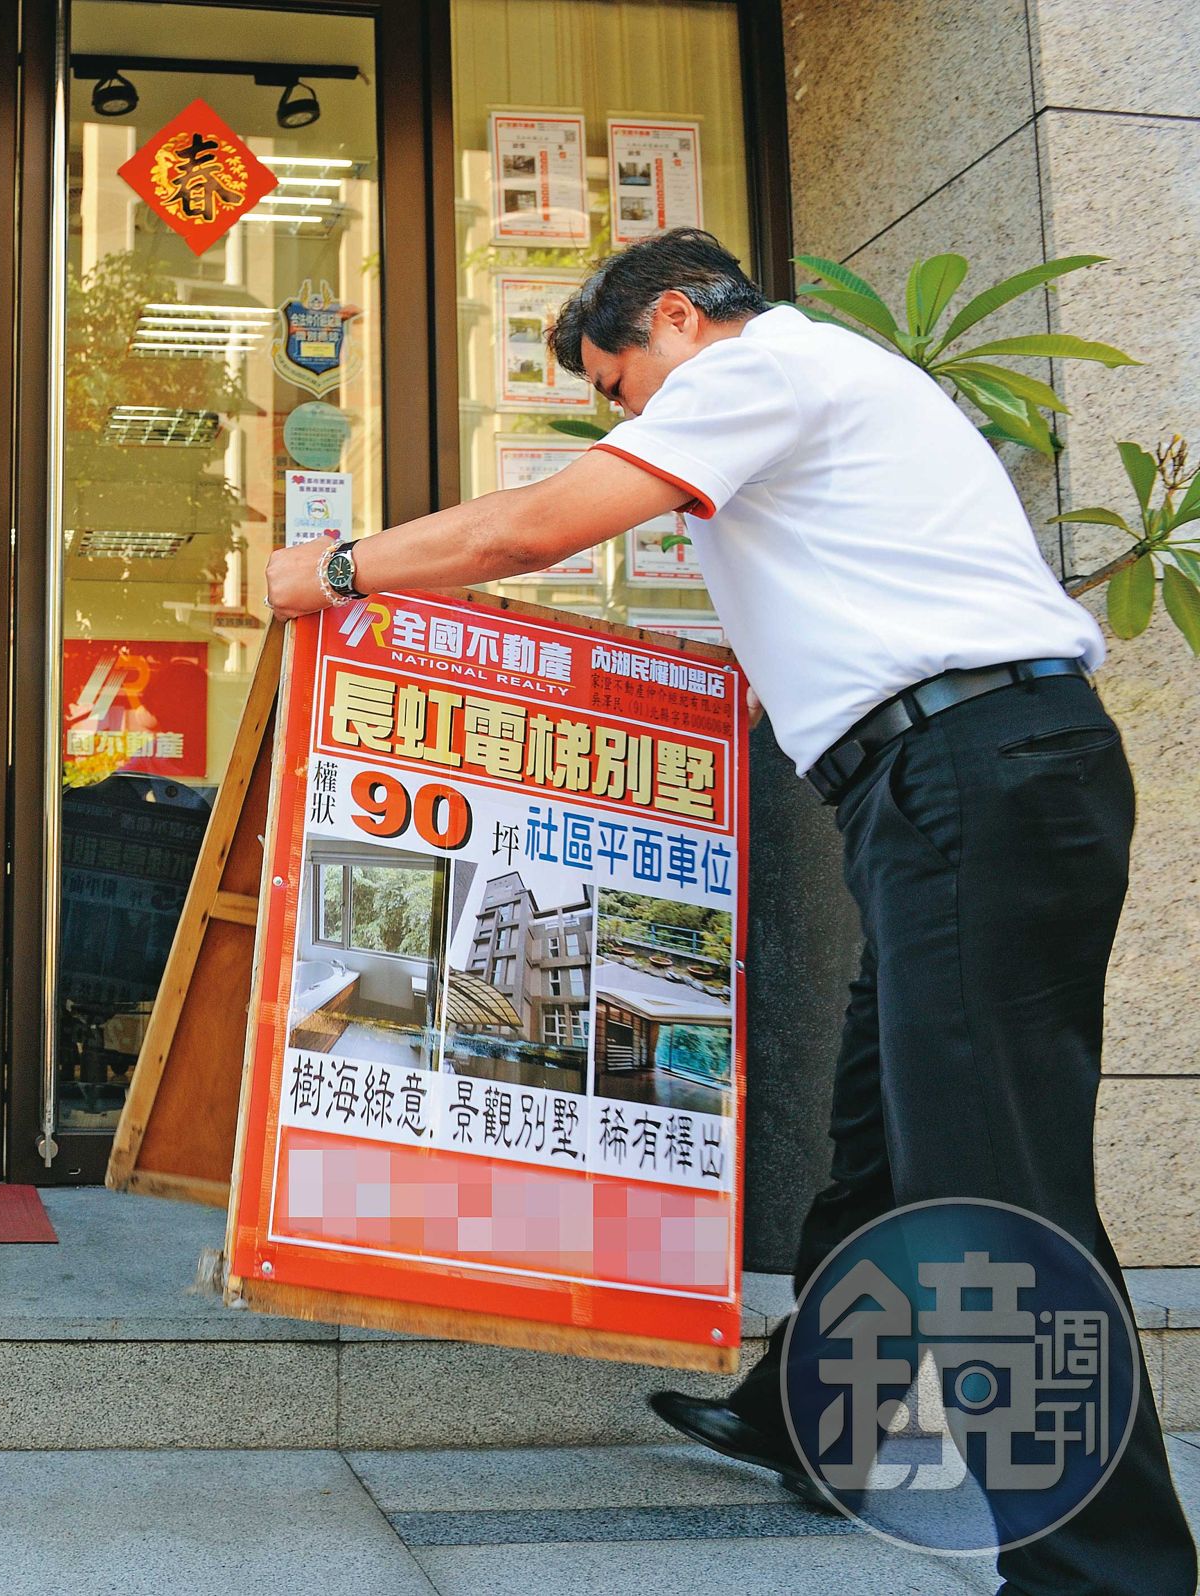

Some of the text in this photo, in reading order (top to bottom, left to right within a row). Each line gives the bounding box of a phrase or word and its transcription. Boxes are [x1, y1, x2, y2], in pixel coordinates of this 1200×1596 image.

[173, 133, 245, 222] 春
[391, 651, 570, 697] NATIONAL REALTY
[392, 608, 573, 684] 全國不動產
[591, 645, 726, 699] 內湖民權加盟店
[329, 671, 717, 822] 長虹電梯別墅
[310, 760, 733, 897] 權狀 90 坪 社區平面車位
[599, 1104, 726, 1179] 稀有釋出
